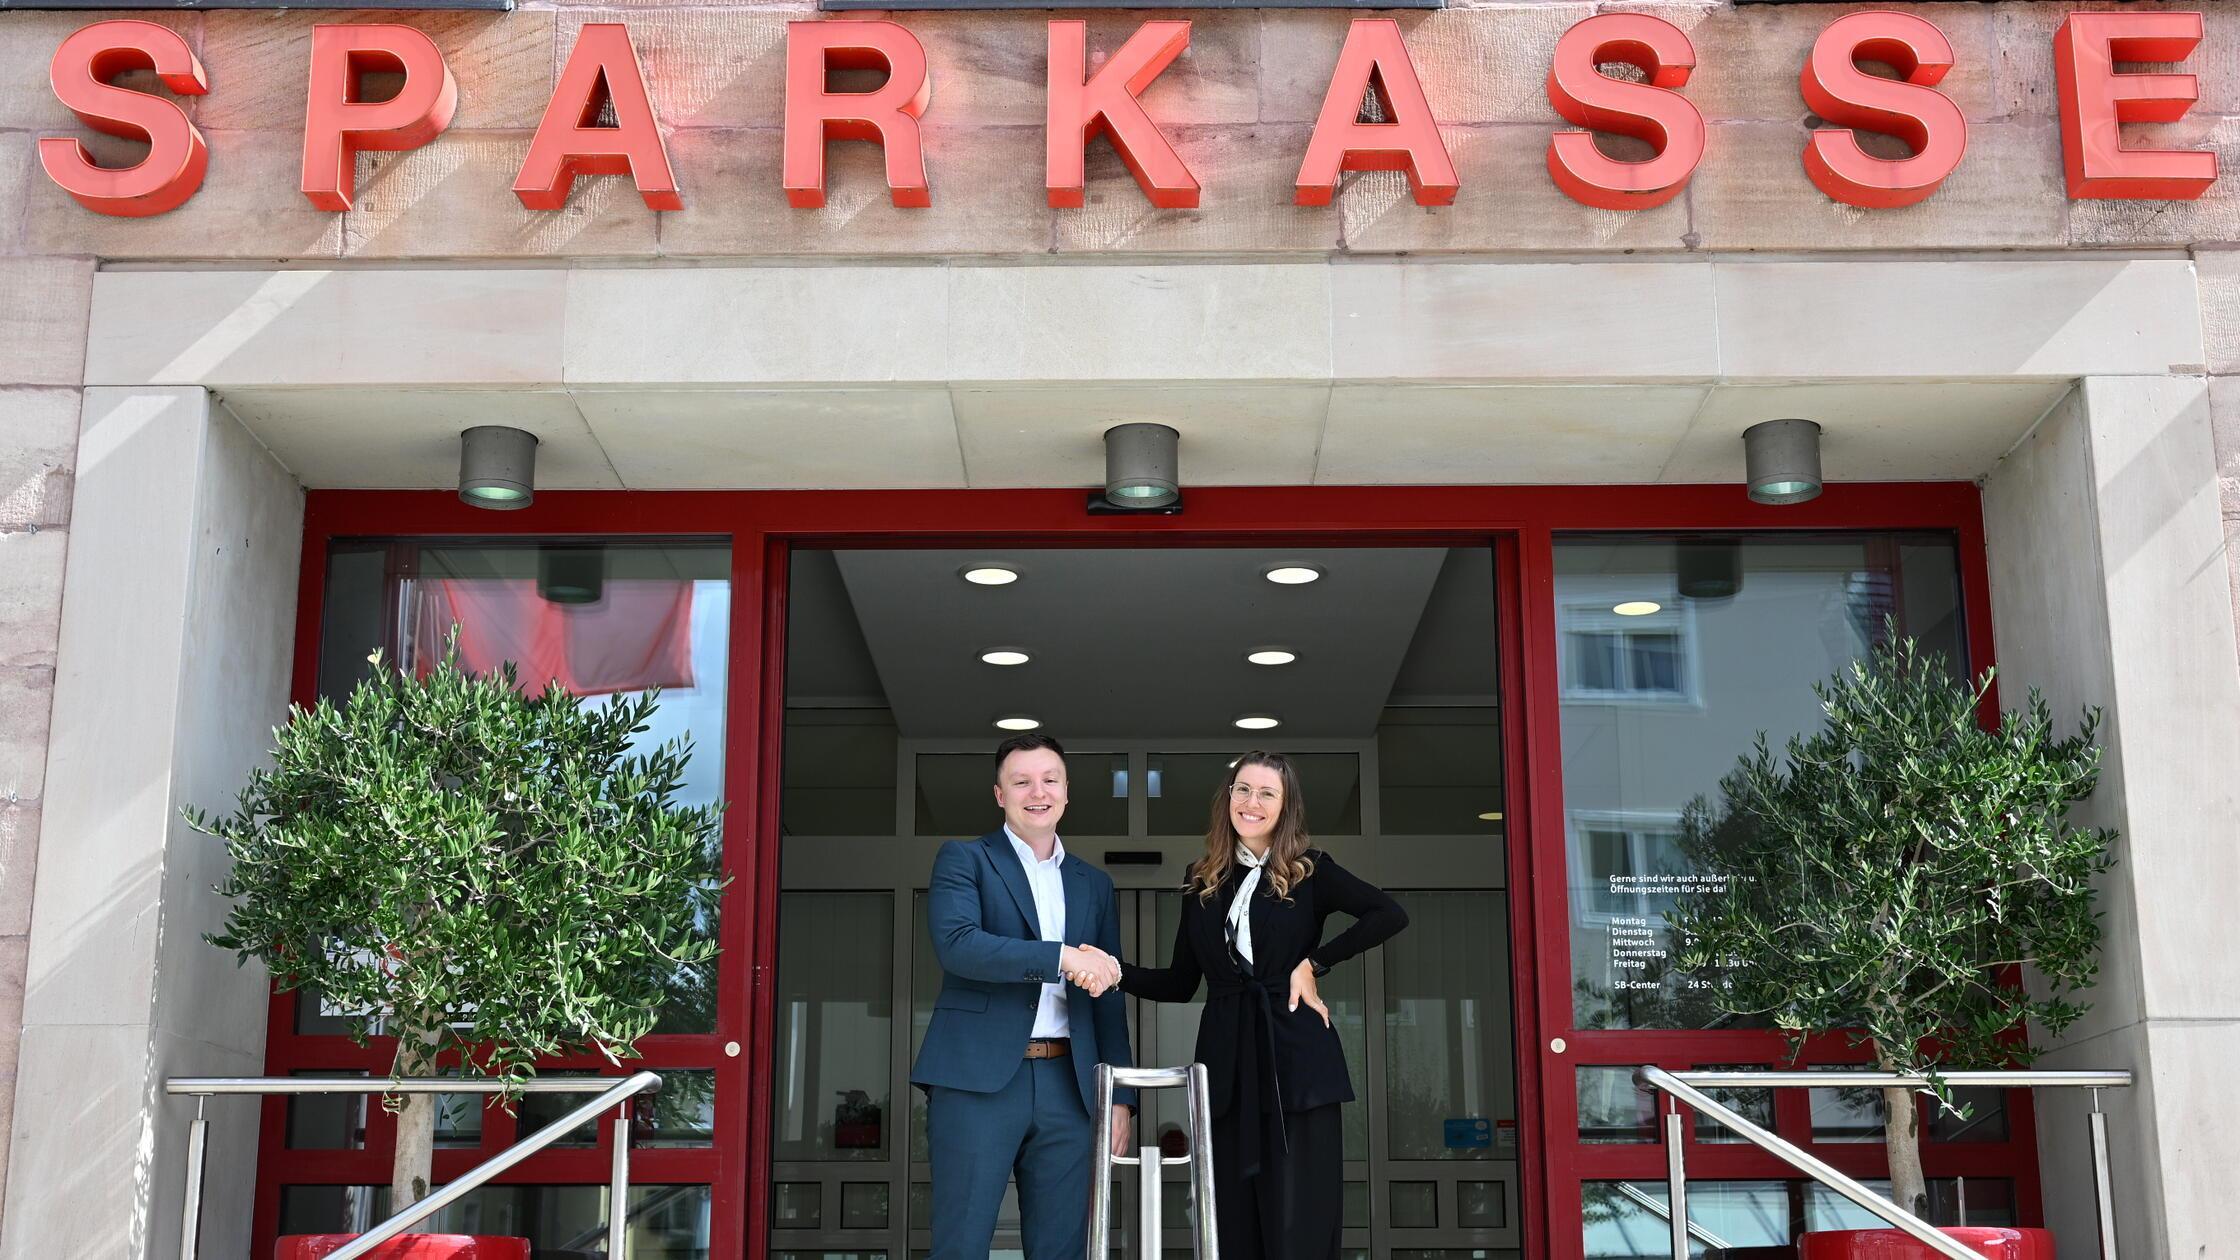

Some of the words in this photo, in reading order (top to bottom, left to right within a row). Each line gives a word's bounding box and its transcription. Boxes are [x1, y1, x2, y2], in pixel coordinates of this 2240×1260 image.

[38, 12, 2219, 215] SPARKASSE
[1609, 874, 1637, 883] Gerne
[1638, 874, 1658, 883] sind
[1660, 874, 1675, 883] wir
[1676, 874, 1698, 883] auch
[1610, 883, 1680, 895] Öffnungszeiten
[1681, 884, 1695, 893] für
[1696, 885, 1711, 893] Sie
[1611, 917, 1646, 926] Montag
[1612, 927, 1653, 938] Dienstag
[1612, 938, 1655, 946] Mittwoch
[1613, 949, 1667, 958] Donnerstag
[1613, 959, 1646, 969] Freitag
[1614, 981, 1661, 989] SB-Center
[1687, 980, 1700, 989] 24
